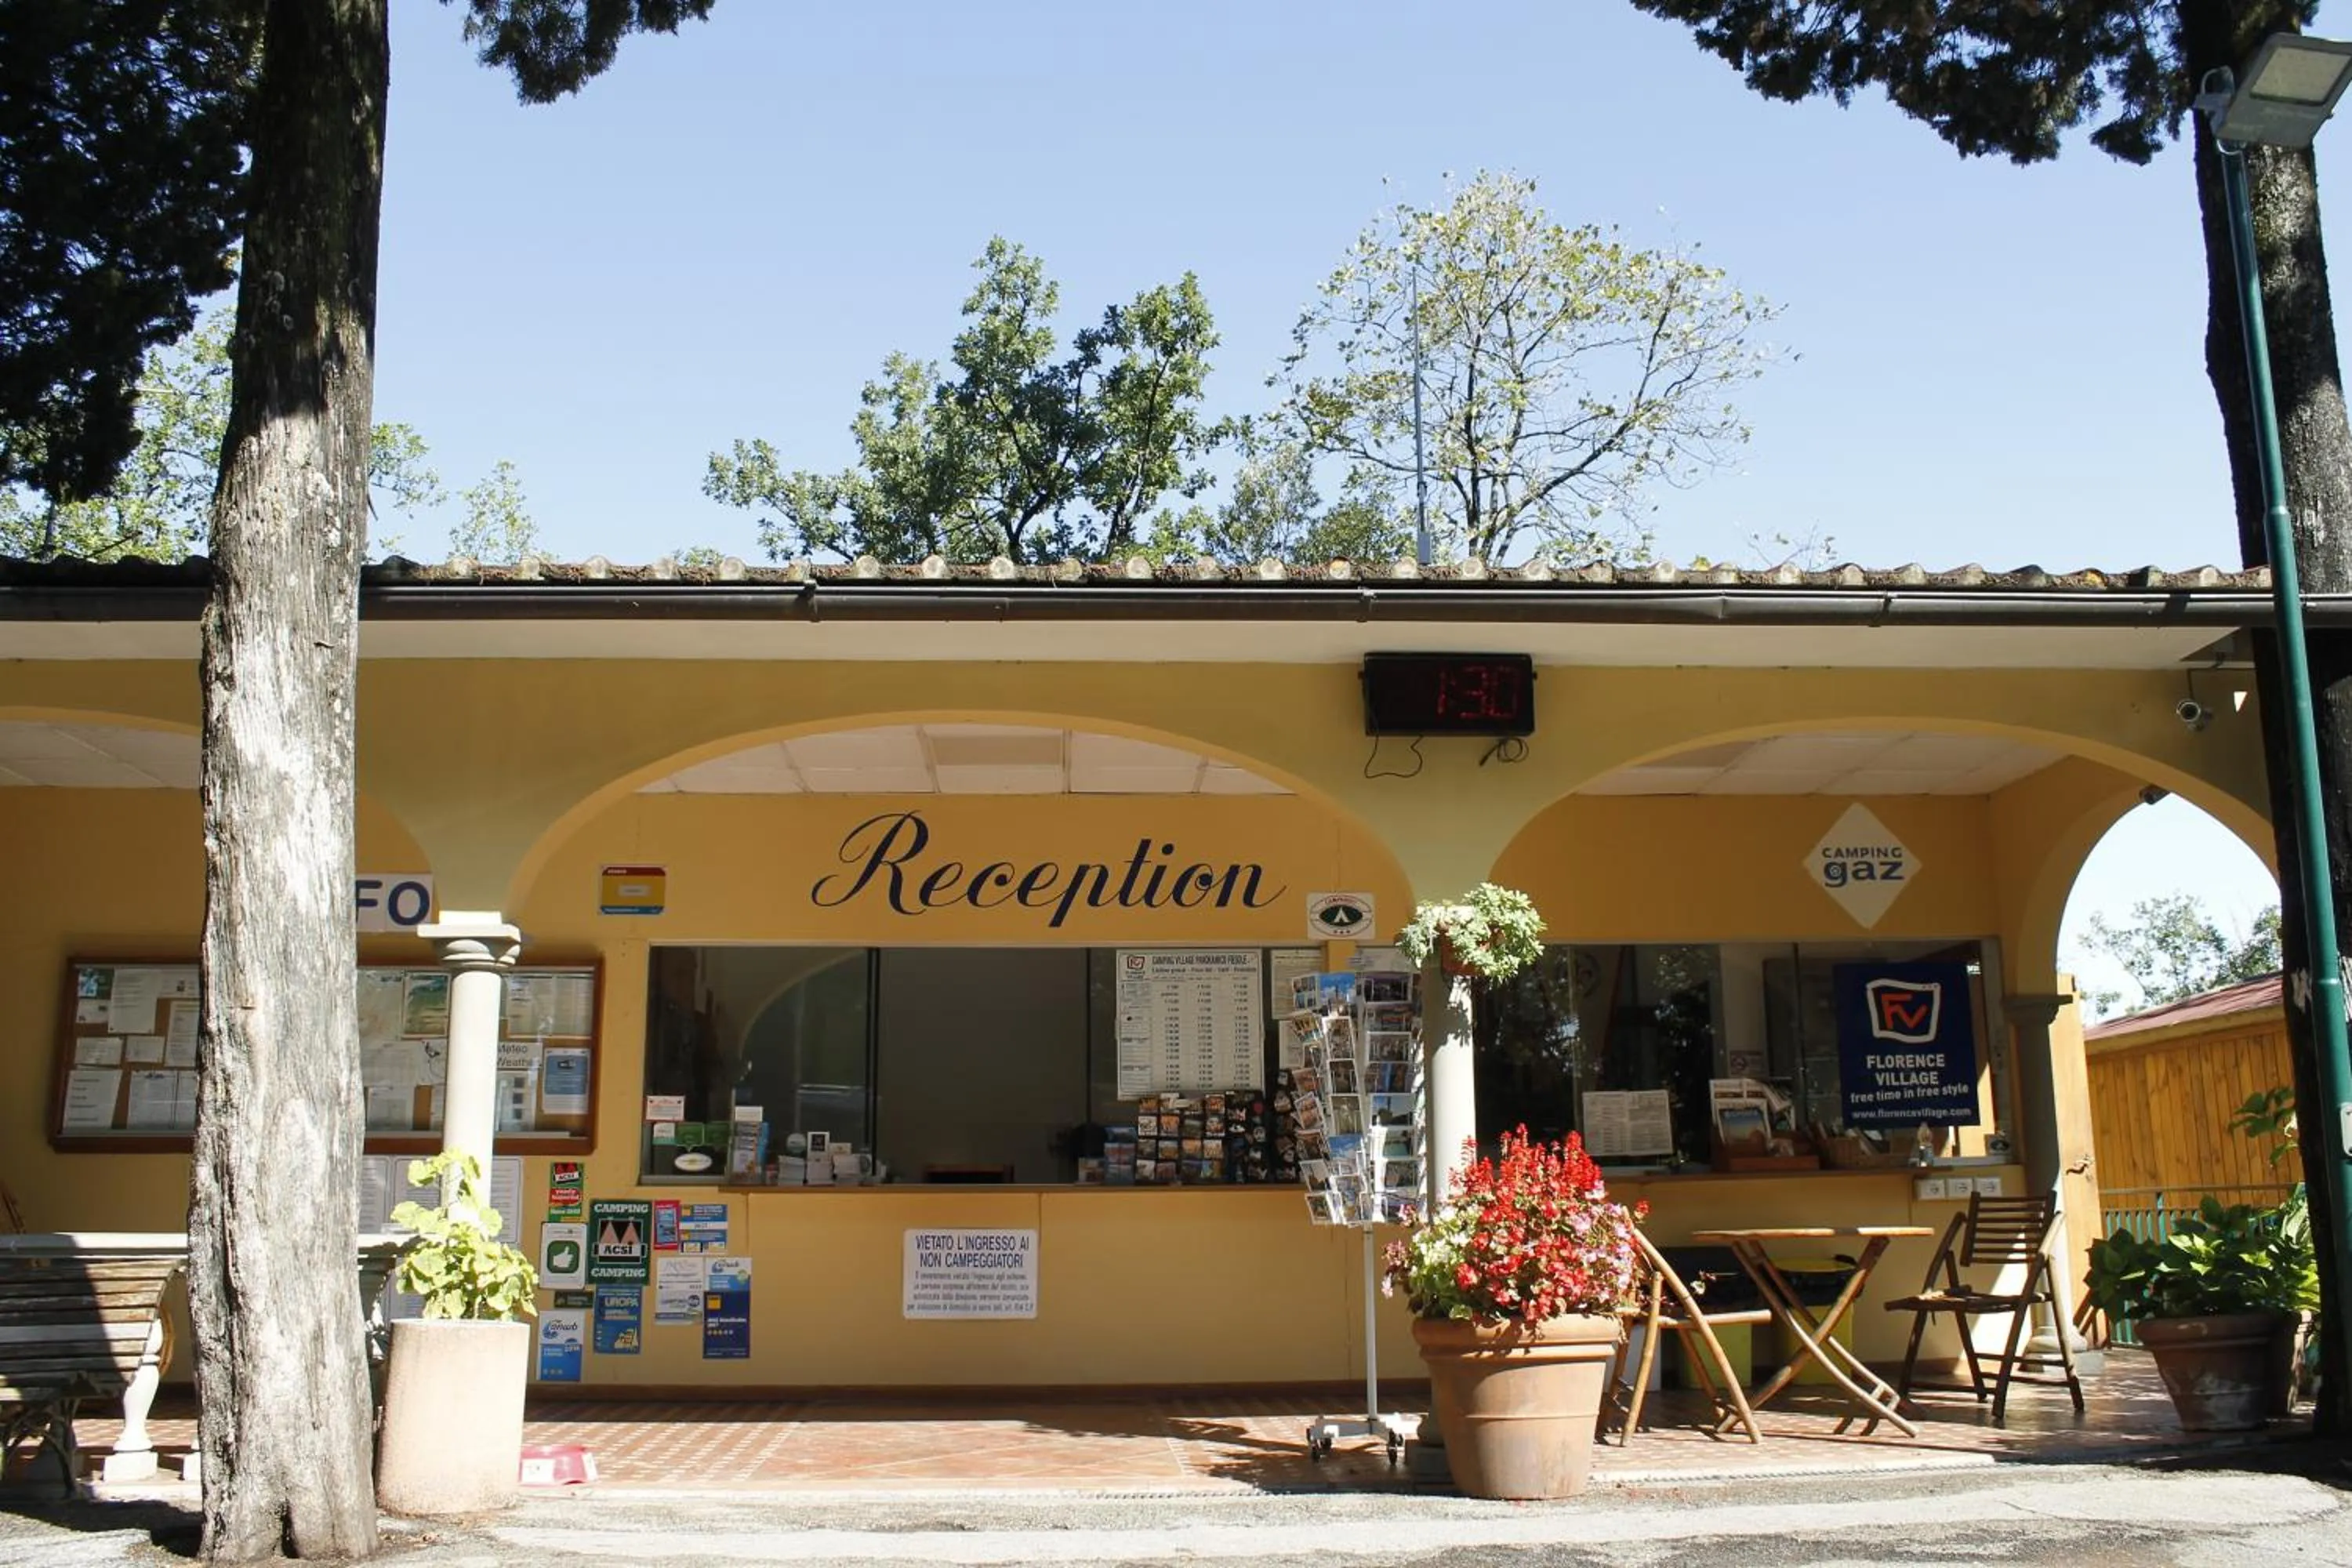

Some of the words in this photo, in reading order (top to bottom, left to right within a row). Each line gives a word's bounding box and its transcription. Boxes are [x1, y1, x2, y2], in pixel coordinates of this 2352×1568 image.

[1821, 847, 1903, 859] CAMPING
[811, 809, 1288, 928] Reception
[1823, 860, 1905, 888] gaz
[1866, 1054, 1946, 1069] FLORENCE
[1875, 1072, 1940, 1086] VILLAGE
[1850, 1092, 1874, 1103] free
[1876, 1088, 1901, 1101] time
[1904, 1087, 1915, 1098] in
[1916, 1085, 1940, 1097] free
[1942, 1083, 1969, 1097] style
[1852, 1106, 1972, 1120] www.florencevillage.com
[593, 1203, 649, 1214] CAMPING
[915, 1235, 954, 1251] VIETATO
[957, 1235, 1016, 1251] L'INGRESSO
[1020, 1235, 1029, 1250] AI
[920, 1253, 942, 1268] NON
[945, 1253, 1023, 1268] CAMPEGGIATORI
[590, 1267, 647, 1278] CAMPING
